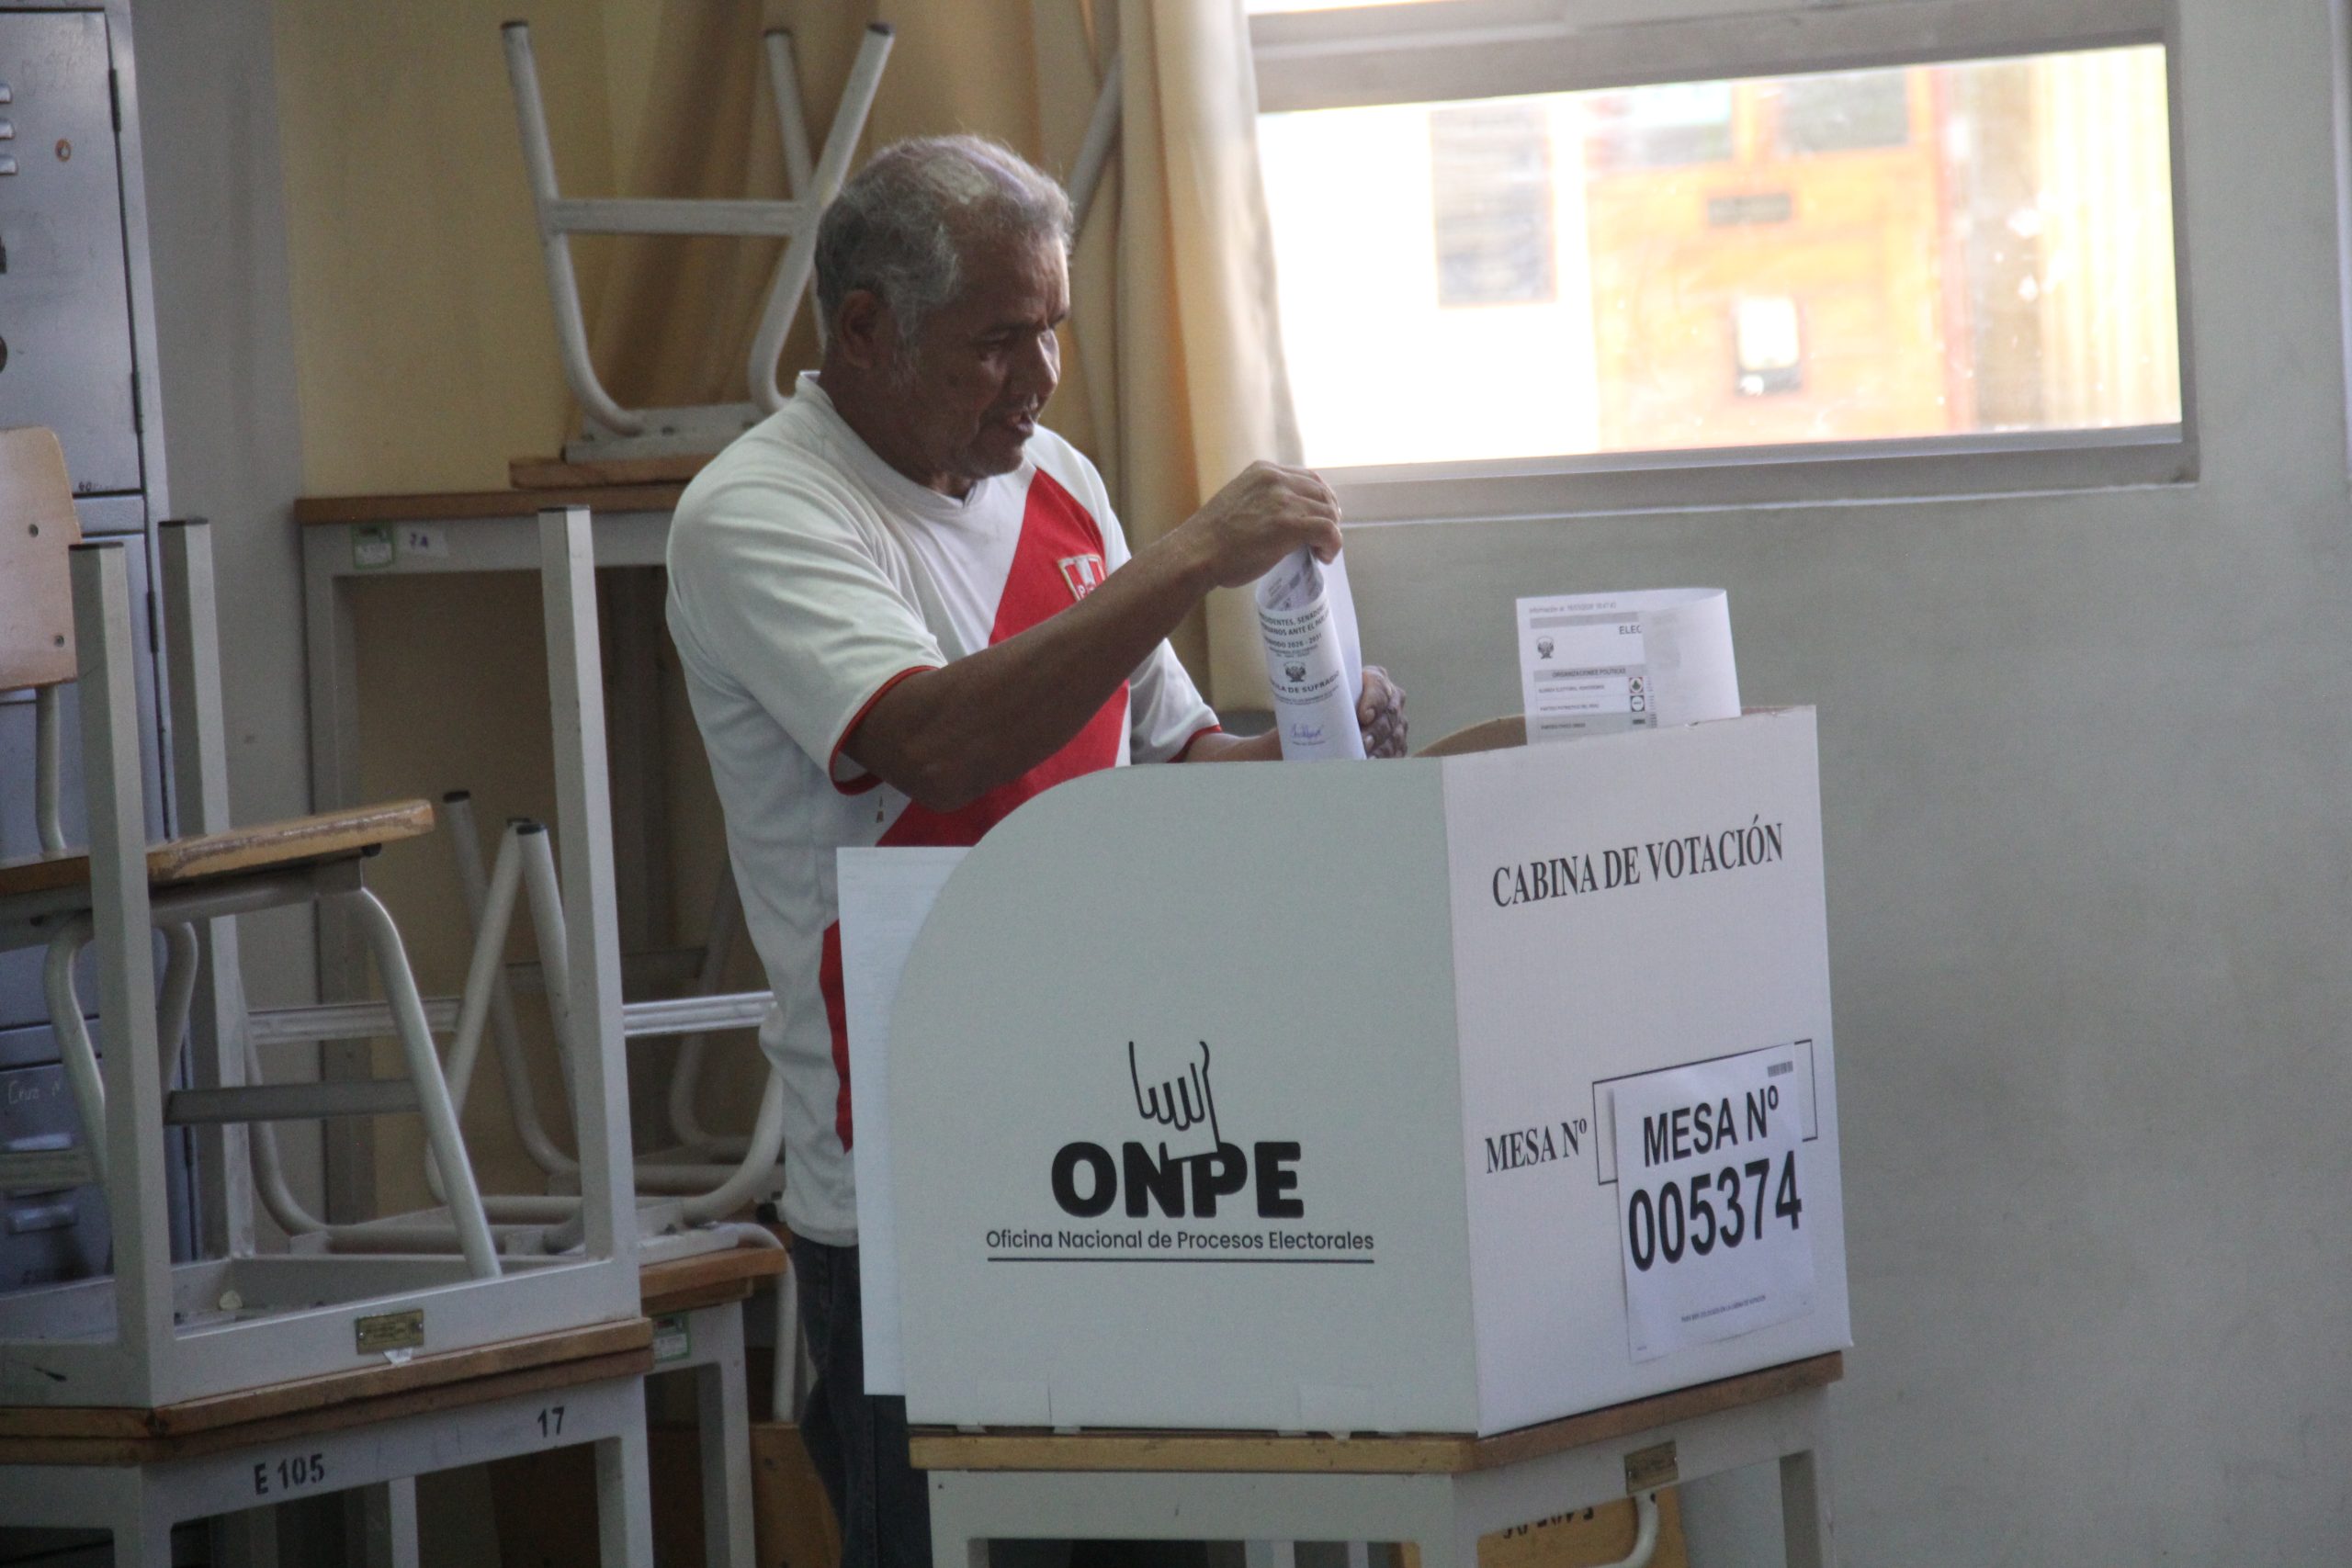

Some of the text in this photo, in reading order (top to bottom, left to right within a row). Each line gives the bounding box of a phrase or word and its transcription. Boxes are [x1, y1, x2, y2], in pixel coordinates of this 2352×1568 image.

[1492, 814, 1783, 908] CABINA DE VOTACIÓN
[1485, 1126, 1558, 1174] MESA
[1643, 1098, 1739, 1168] MESA
[1051, 1141, 1305, 1219] ONPE
[986, 1229, 1374, 1251] Oficina Nacional de Procesos Electorales
[1629, 1150, 1803, 1272] 005374
[537, 1406, 565, 1438] 17
[254, 1453, 325, 1495] E 105
